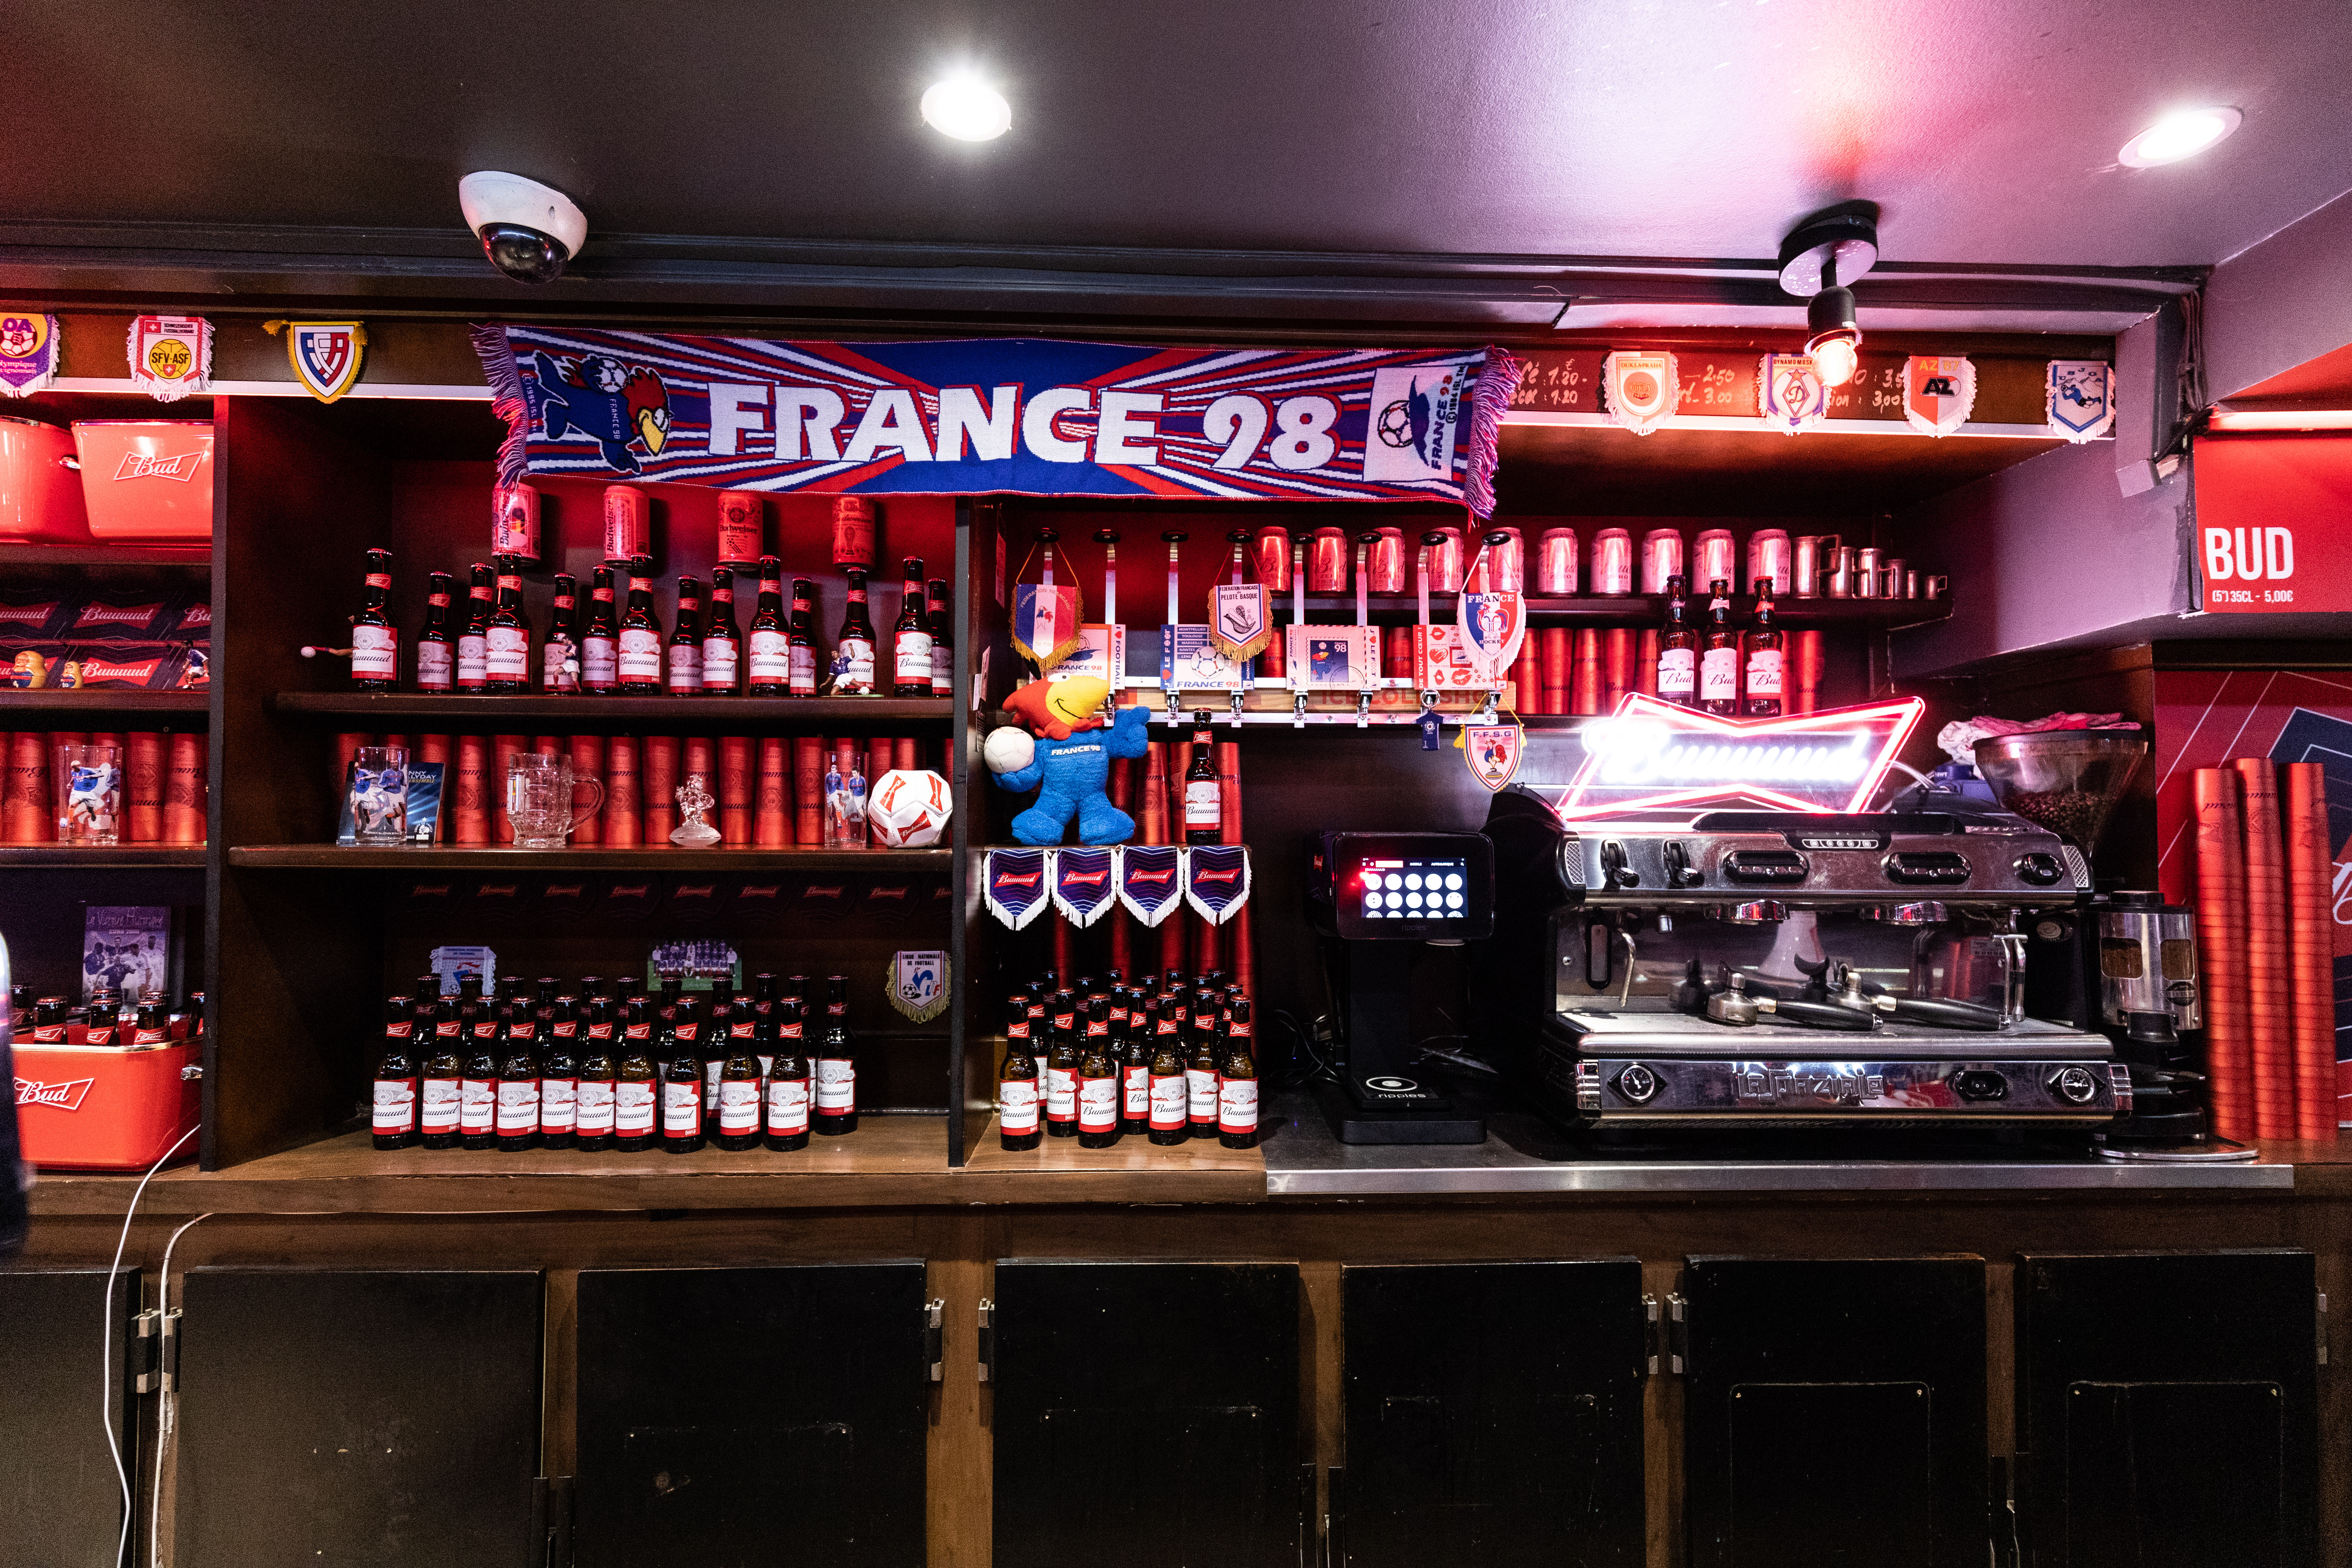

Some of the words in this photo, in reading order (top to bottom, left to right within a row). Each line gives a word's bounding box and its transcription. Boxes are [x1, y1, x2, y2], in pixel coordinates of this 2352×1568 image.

[3, 317, 33, 333] OA
[1919, 360, 1938, 371] AZ
[1439, 375, 1453, 396] 98
[1922, 377, 1955, 396] AZ
[708, 381, 1166, 464] FRANCE
[1204, 390, 1343, 471] 98
[1431, 400, 1448, 470] FRANCE
[129, 455, 181, 476] Bud
[606, 500, 615, 552] Budweiser
[719, 524, 758, 534] Budweiser
[2205, 527, 2294, 580] BUD
[1467, 594, 1514, 603] FRANCE
[2231, 591, 2254, 603] 35CL
[2265, 590, 2294, 603] 5,00€
[1370, 645, 1375, 655] LE
[1164, 657, 1170, 668] LE
[1419, 678, 1424, 688] DE
[1664, 672, 1693, 684] Bud
[1708, 673, 1735, 685] Bud
[1753, 673, 1781, 686] Bud
[1377, 690, 1423, 704] COL
[1051, 746, 1090, 756] FRANCE
[1186, 806, 1220, 815] Buuuuud
[900, 817, 929, 837] Budweiser
[997, 874, 1036, 884] Buuuuud
[1064, 873, 1102, 882] Buuuuud
[1131, 871, 1168, 880] Buuuuud
[1198, 871, 1235, 880] Buuuuud
[140, 1031, 164, 1040] Bud
[15, 1081, 70, 1102] Bud
[720, 1106, 756, 1118] Buuuuud
[769, 1106, 805, 1118] Buuuuud
[1000, 1106, 1036, 1118] Buuuuud
